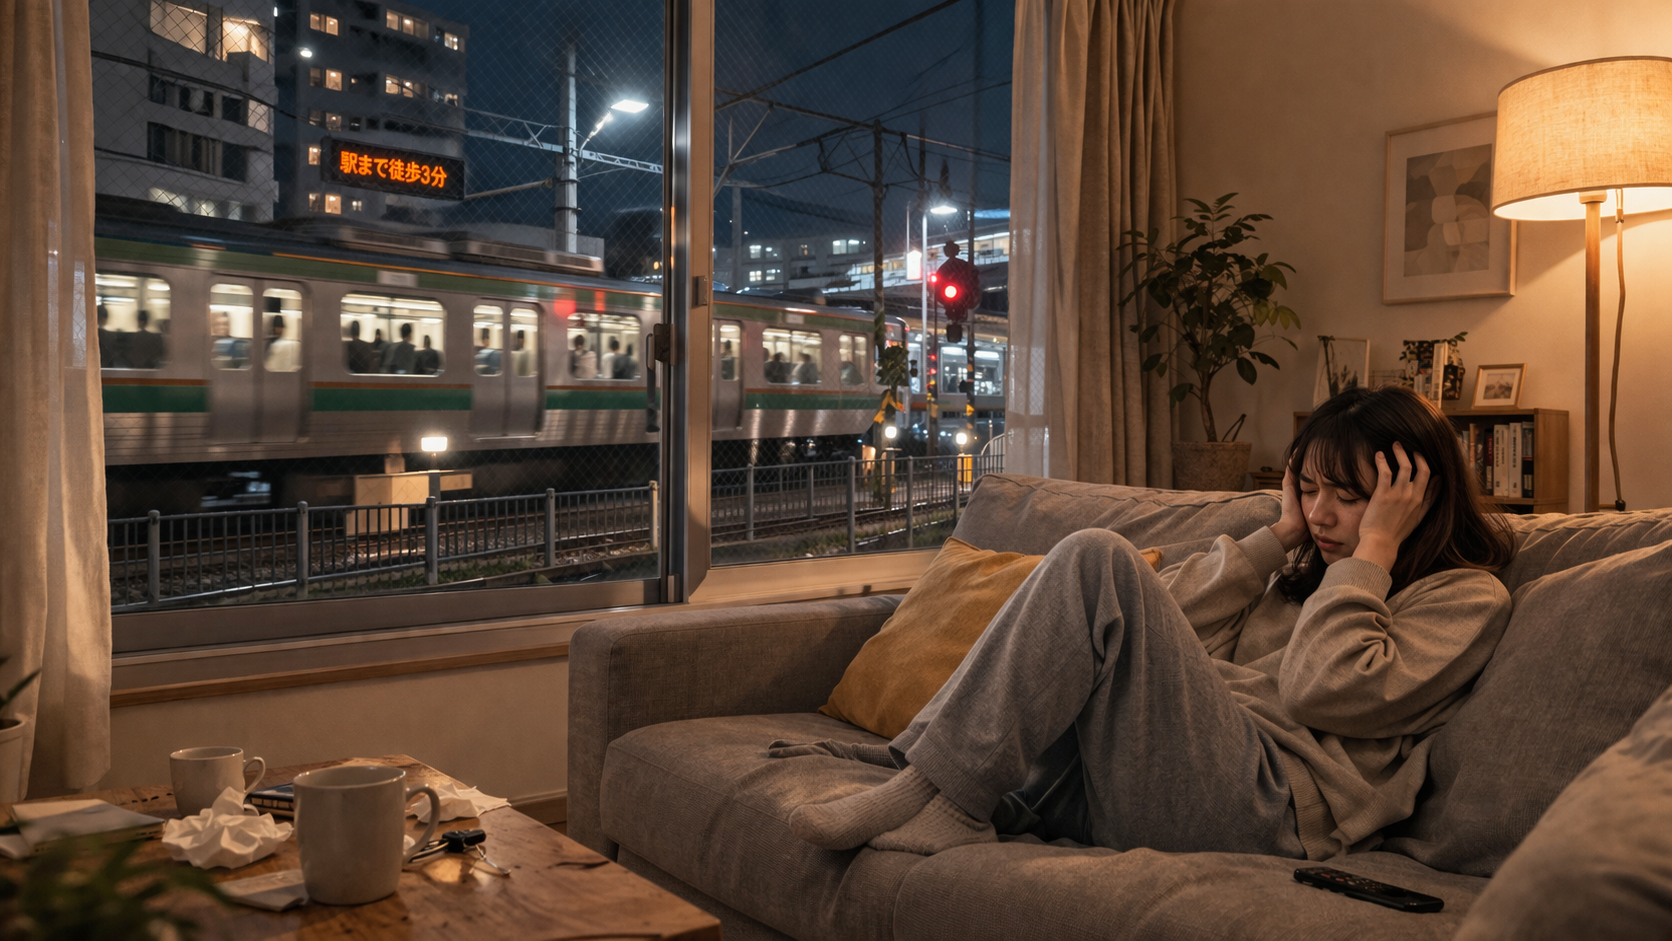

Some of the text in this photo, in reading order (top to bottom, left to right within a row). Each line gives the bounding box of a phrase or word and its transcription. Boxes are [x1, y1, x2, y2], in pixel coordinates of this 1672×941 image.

[340, 151, 447, 187] 駅まで徒歩3分
